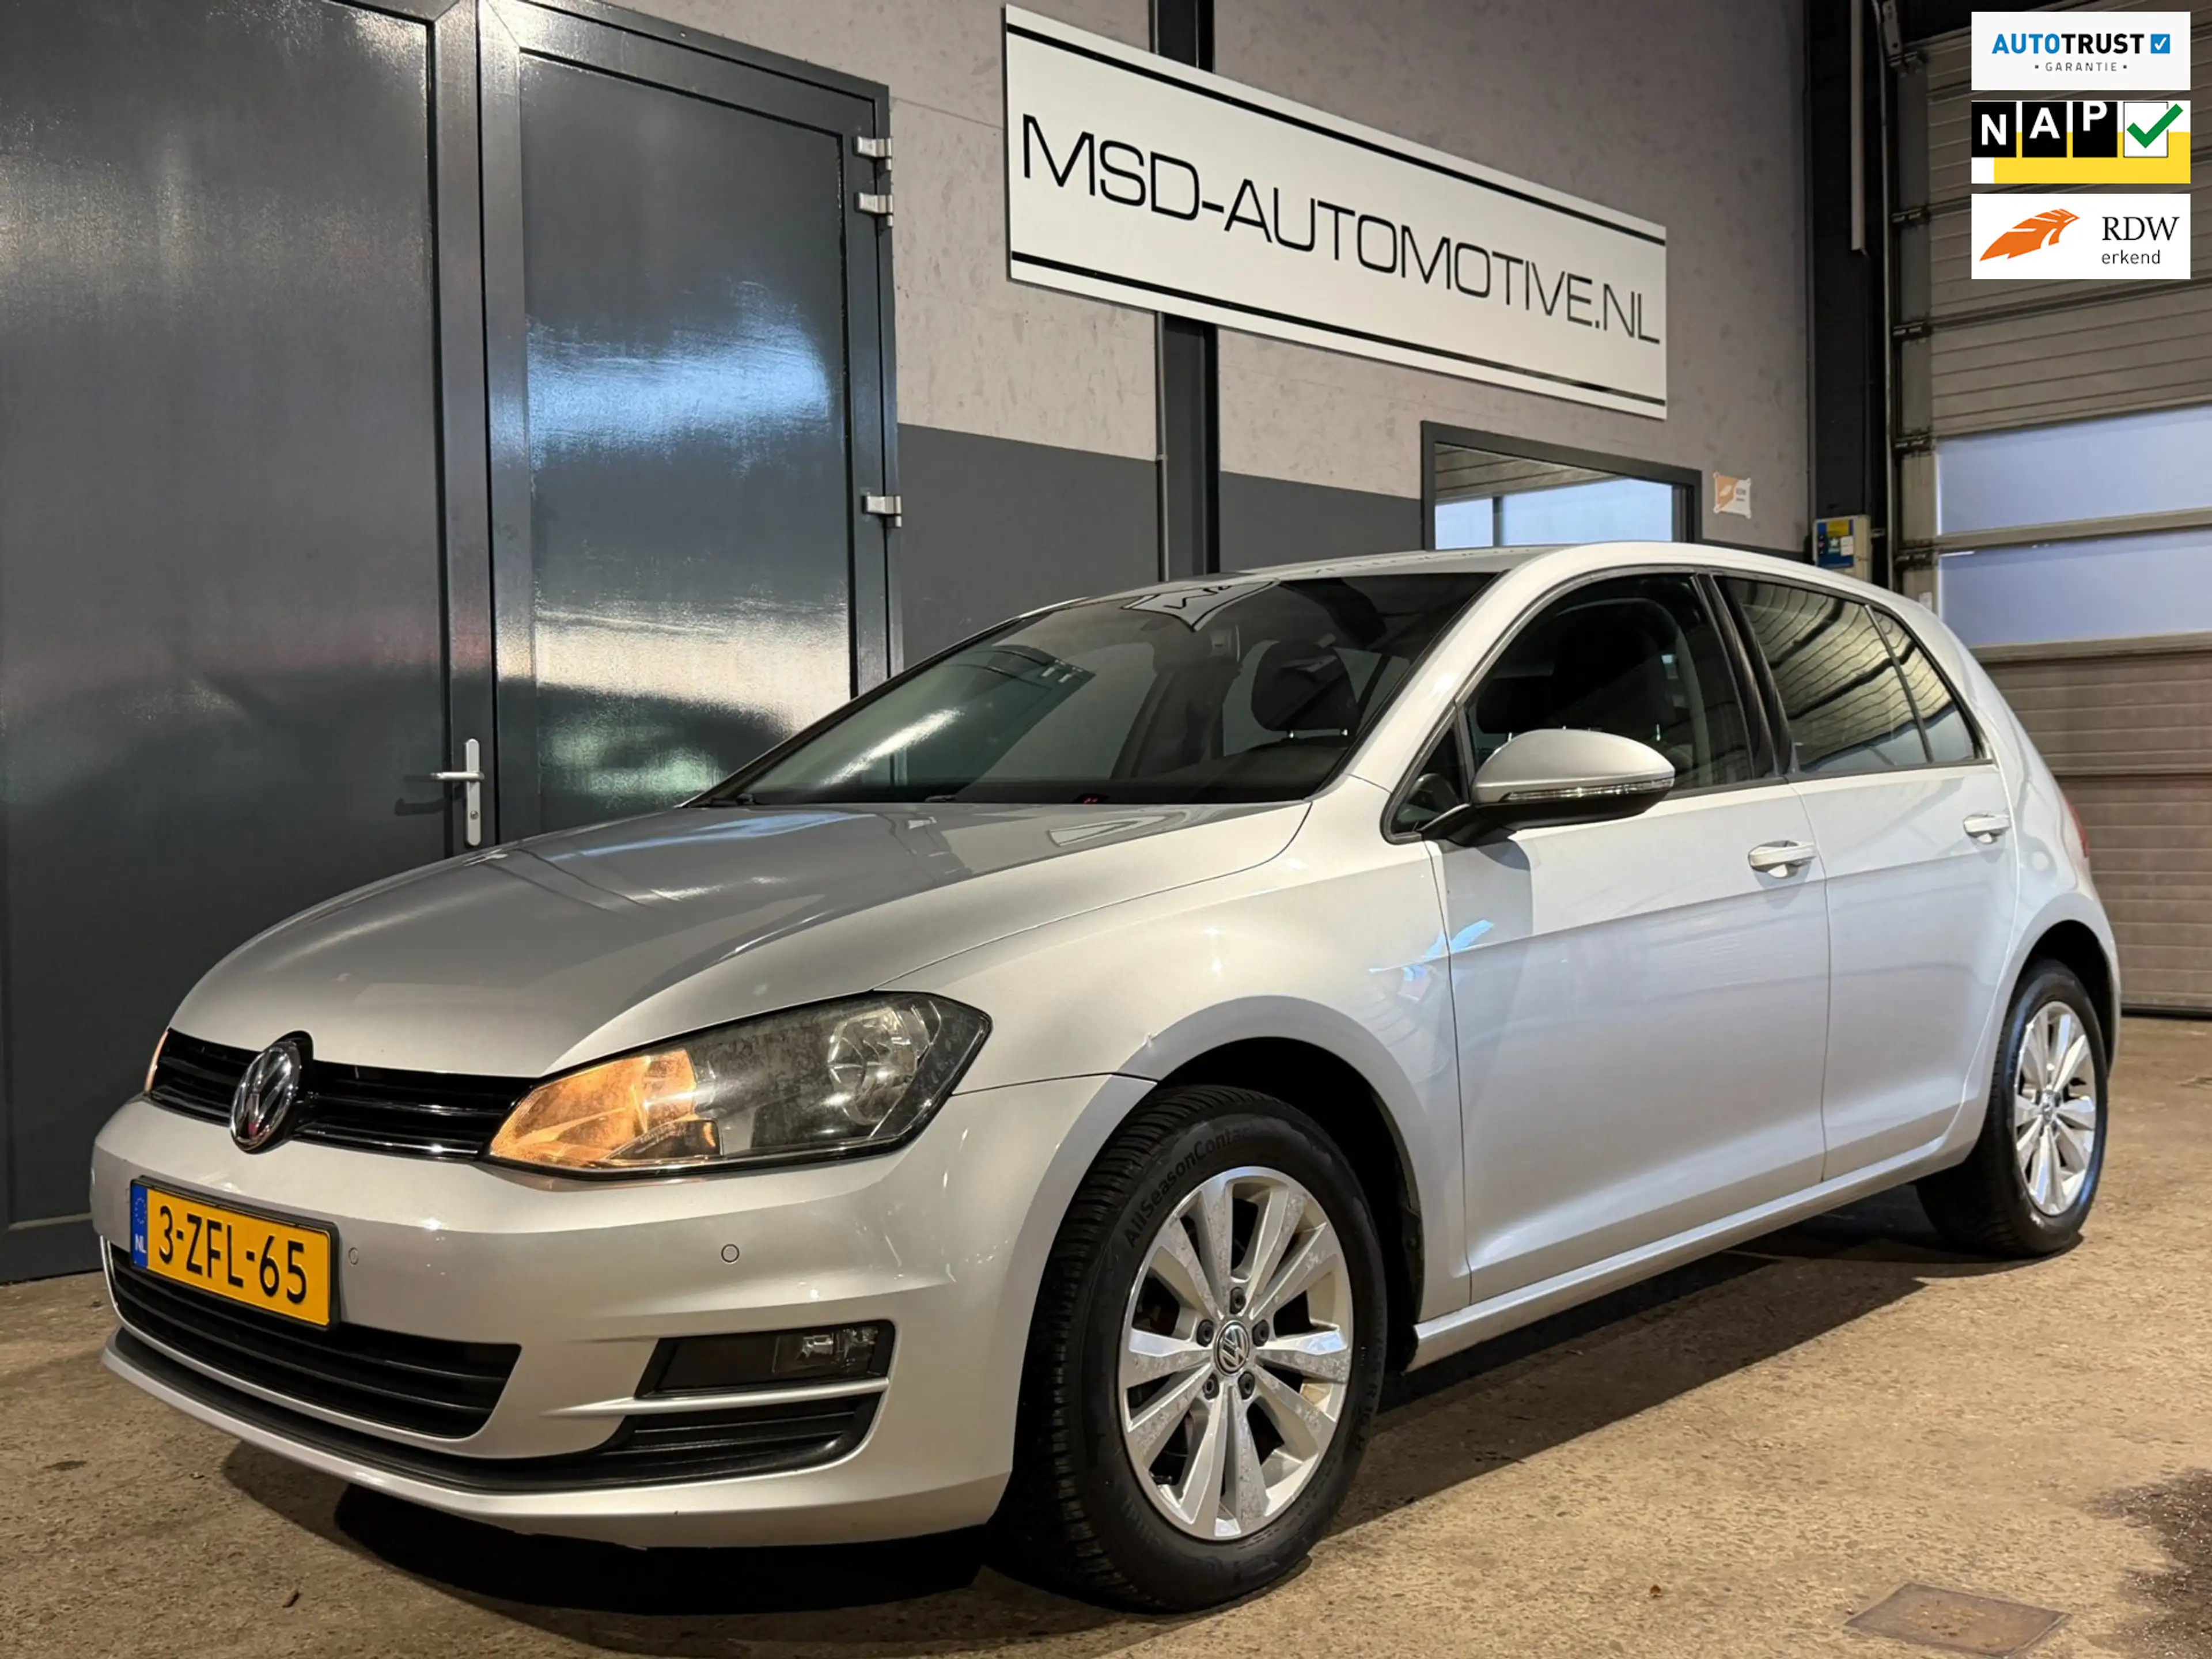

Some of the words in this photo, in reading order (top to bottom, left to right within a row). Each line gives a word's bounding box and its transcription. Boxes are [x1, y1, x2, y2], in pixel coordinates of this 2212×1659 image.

[1022, 113, 1660, 344] MSD-AUTOMOTIVE.NL
[134, 1233, 146, 1253] NL
[158, 1206, 307, 1304] 3-ZFL-65
